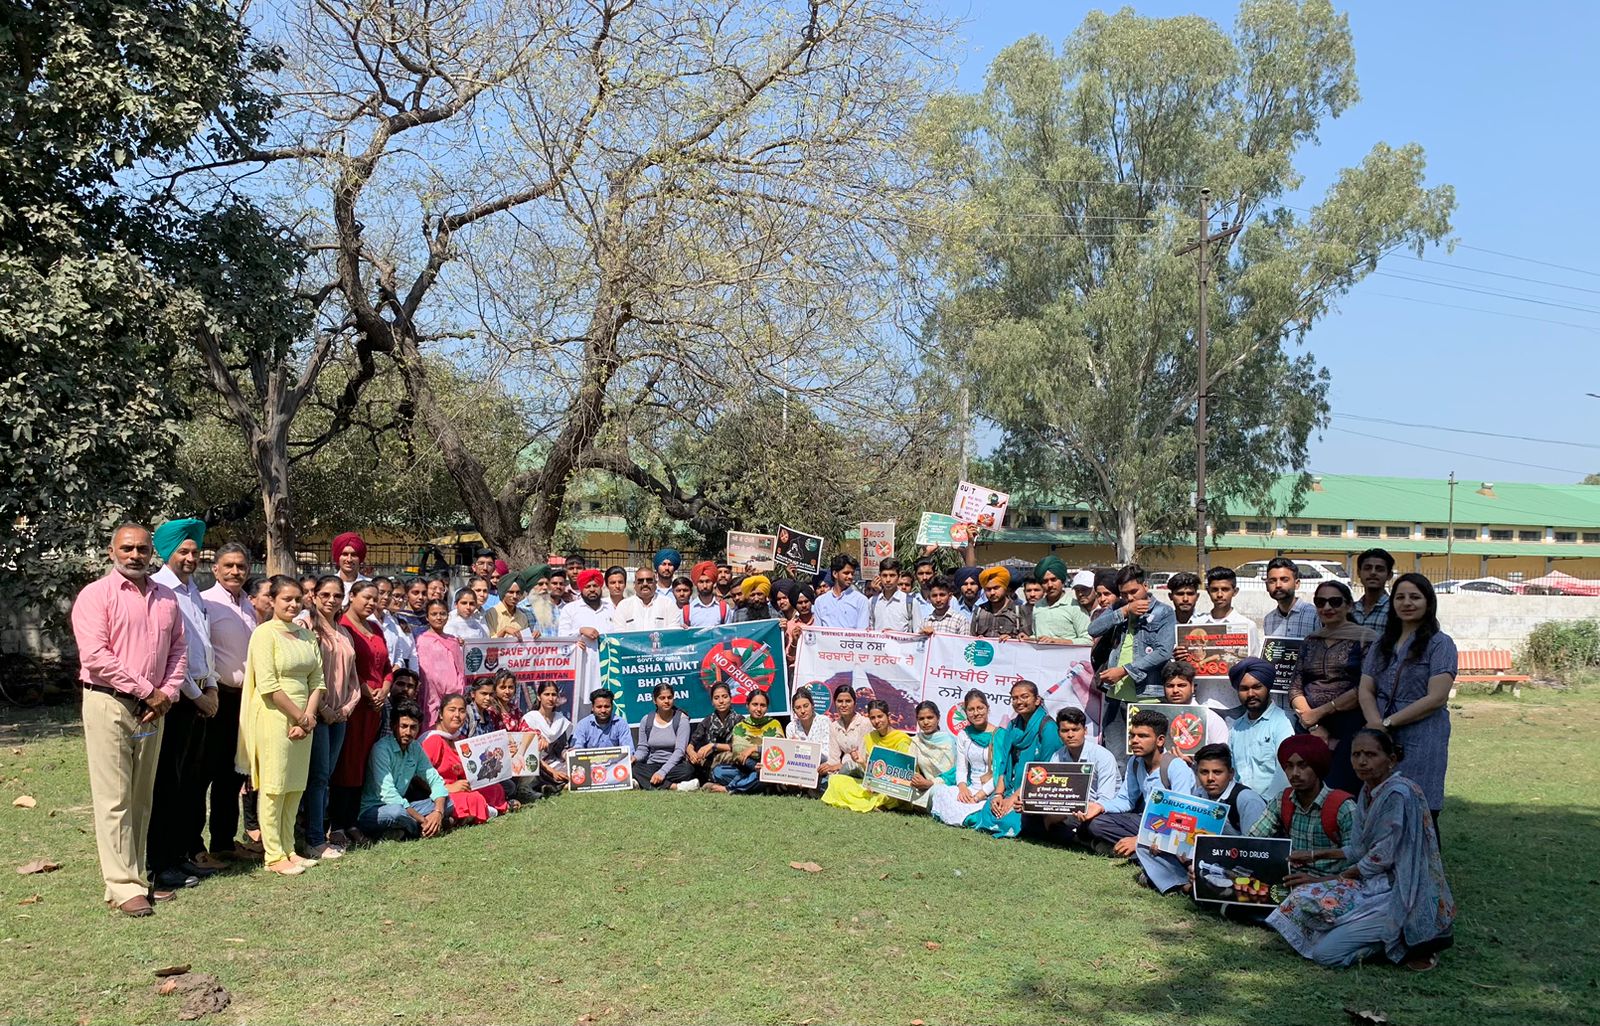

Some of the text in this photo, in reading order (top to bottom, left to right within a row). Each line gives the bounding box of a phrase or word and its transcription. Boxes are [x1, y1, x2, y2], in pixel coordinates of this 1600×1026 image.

[863, 557, 880, 567] DREA
[840, 639, 864, 649] ਹਰੇਕ
[500, 646, 558, 657] SAVE YOUTH
[818, 651, 854, 662] ਬਰਬਾਦੀ
[858, 654, 869, 662] ਦਾ
[508, 658, 570, 668] SAVE NATION
[713, 653, 728, 667] NO
[622, 661, 699, 674] NASHA MUKT
[930, 665, 989, 684] ਪੰਜਾਬੀਓ
[638, 676, 685, 687] BHARAT
[637, 690, 689, 702] ABAN
[938, 686, 963, 699] ਨਸ਼ੇ
[787, 760, 816, 769] AWARENESS
[1162, 799, 1184, 809] DRUG
[1185, 804, 1212, 816] ABUSE
[1212, 848, 1224, 856] SAY
[1225, 848, 1238, 858] NO
[1249, 851, 1269, 859] DRUGS
